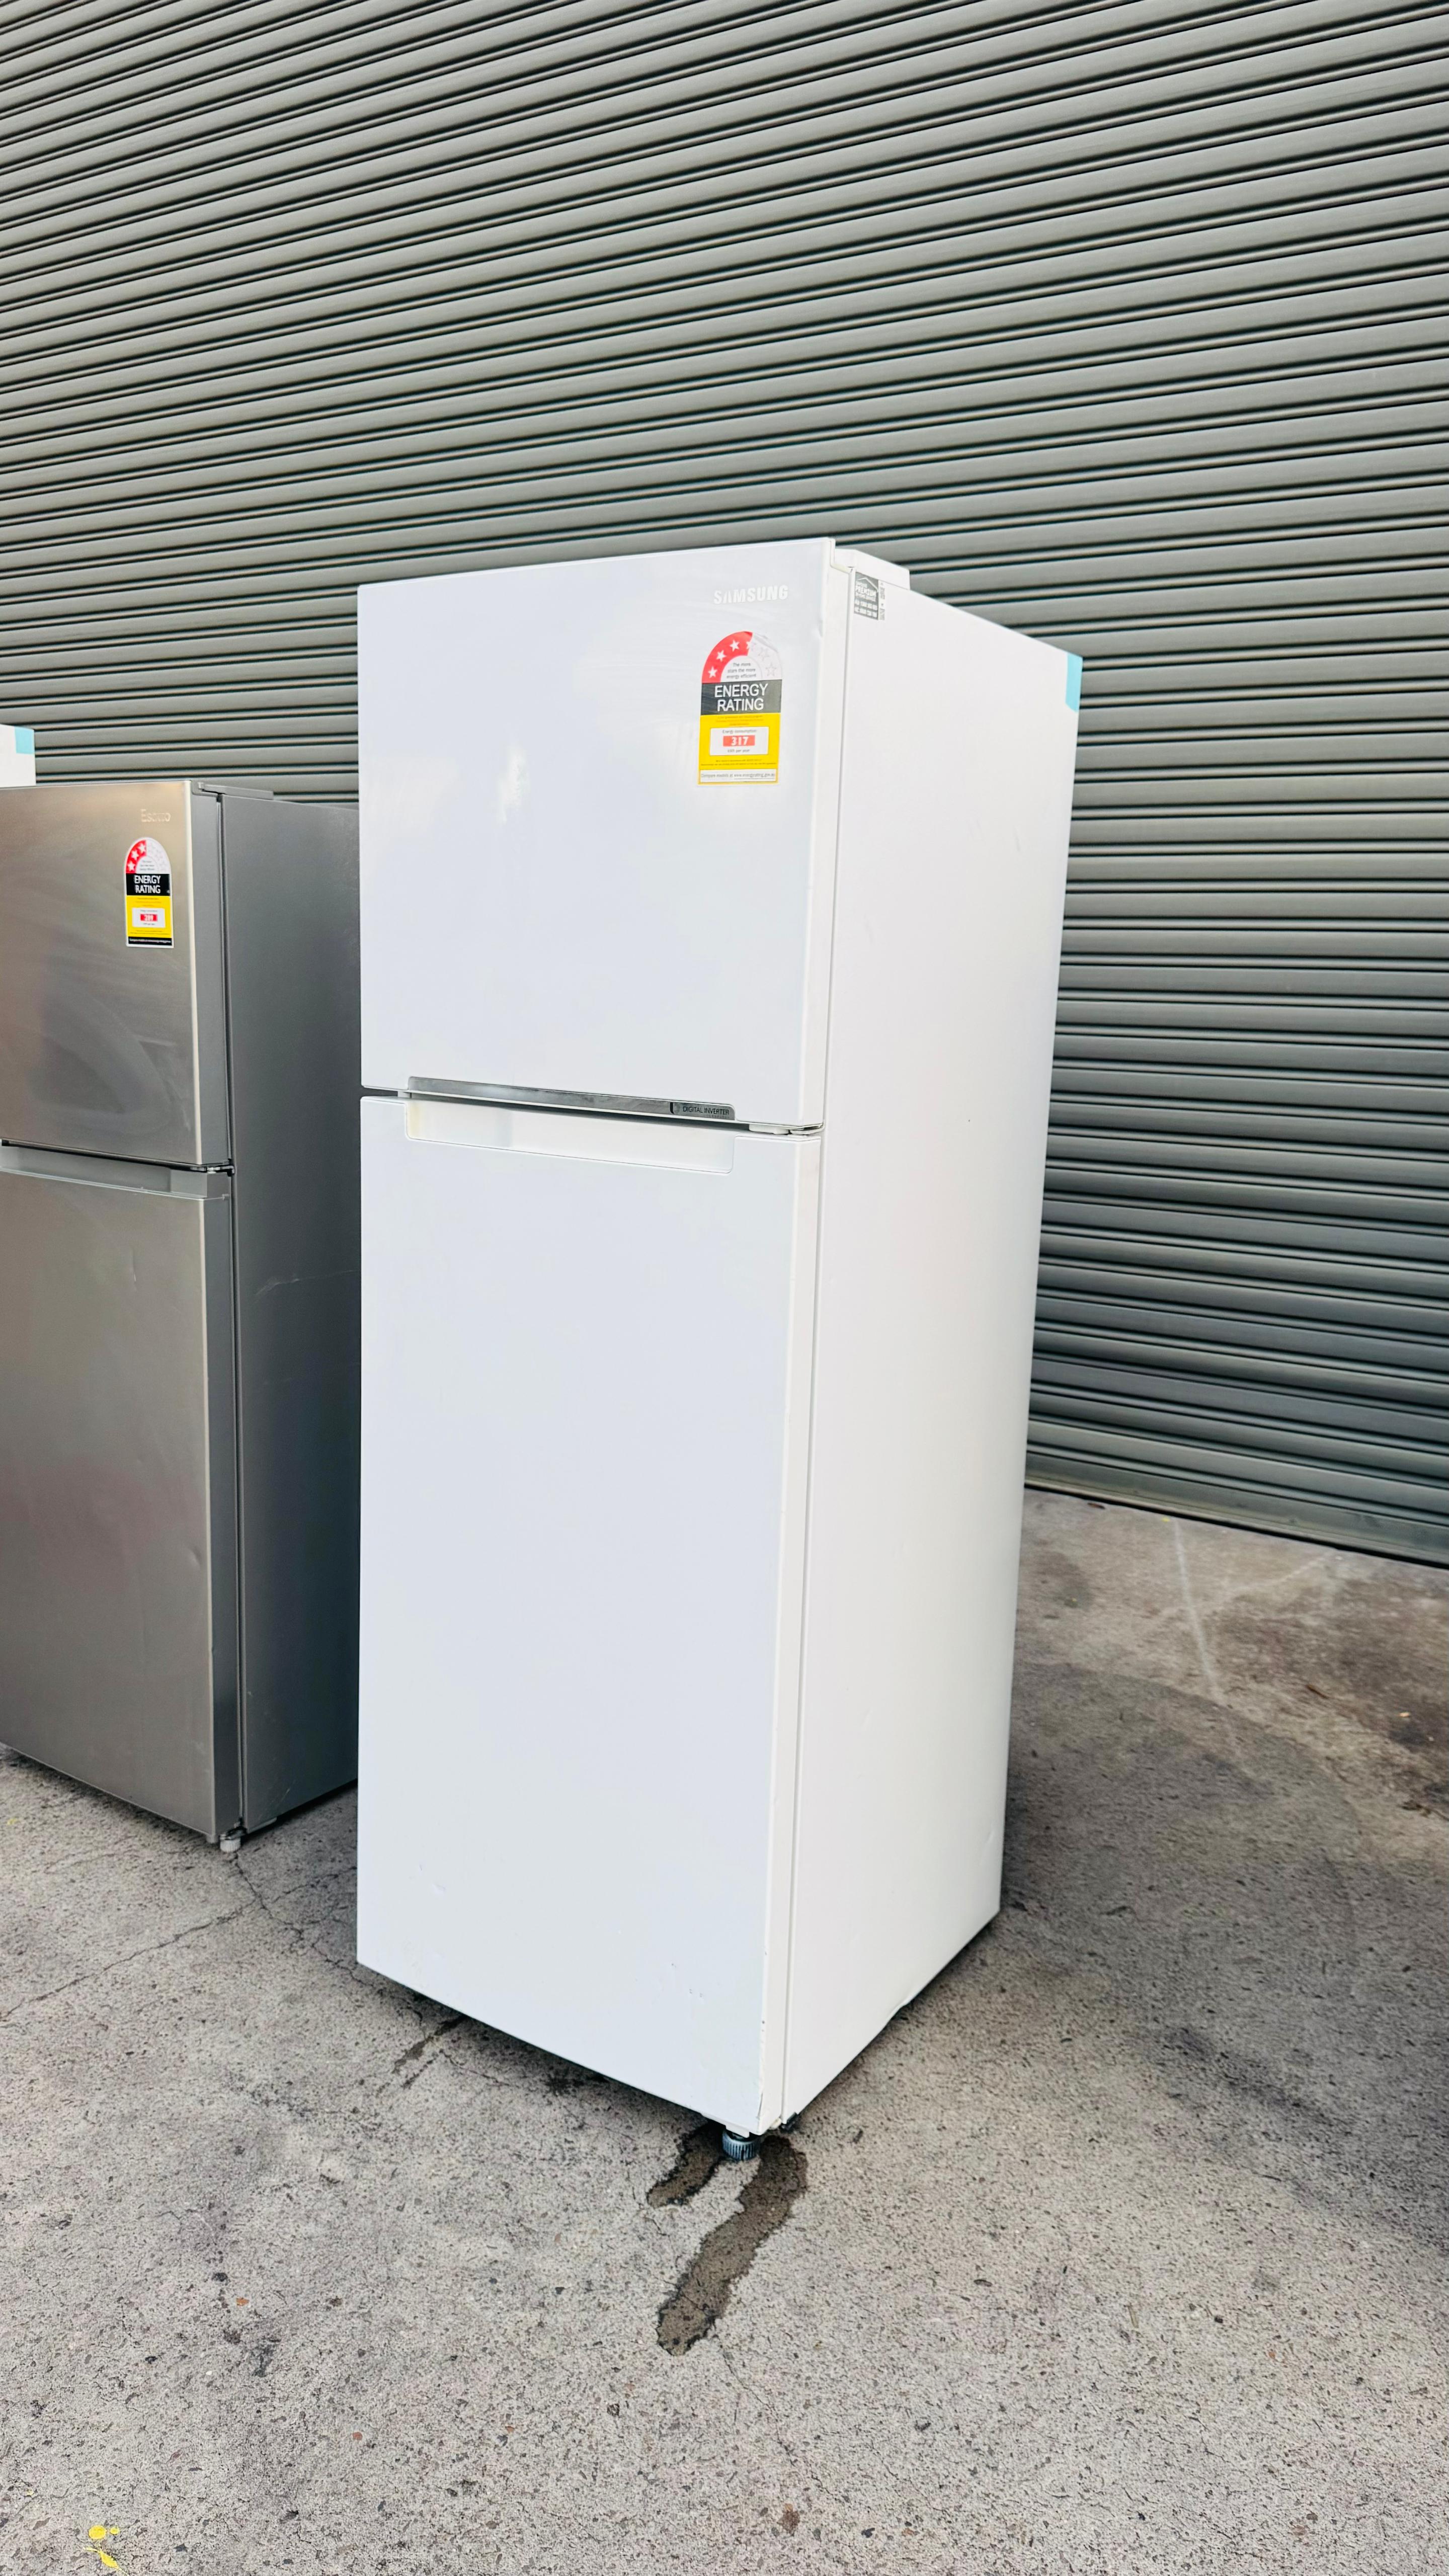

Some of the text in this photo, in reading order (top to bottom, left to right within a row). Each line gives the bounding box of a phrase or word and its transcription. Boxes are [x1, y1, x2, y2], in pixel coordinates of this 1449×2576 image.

[713, 585, 789, 604] SAMSUNG
[714, 683, 768, 698] ENERGY
[717, 698, 764, 712] RATING
[732, 736, 749, 746] 317
[134, 875, 161, 884] ENERGY
[135, 884, 161, 894] RATING
[704, 1107, 730, 1115] INVERTER
